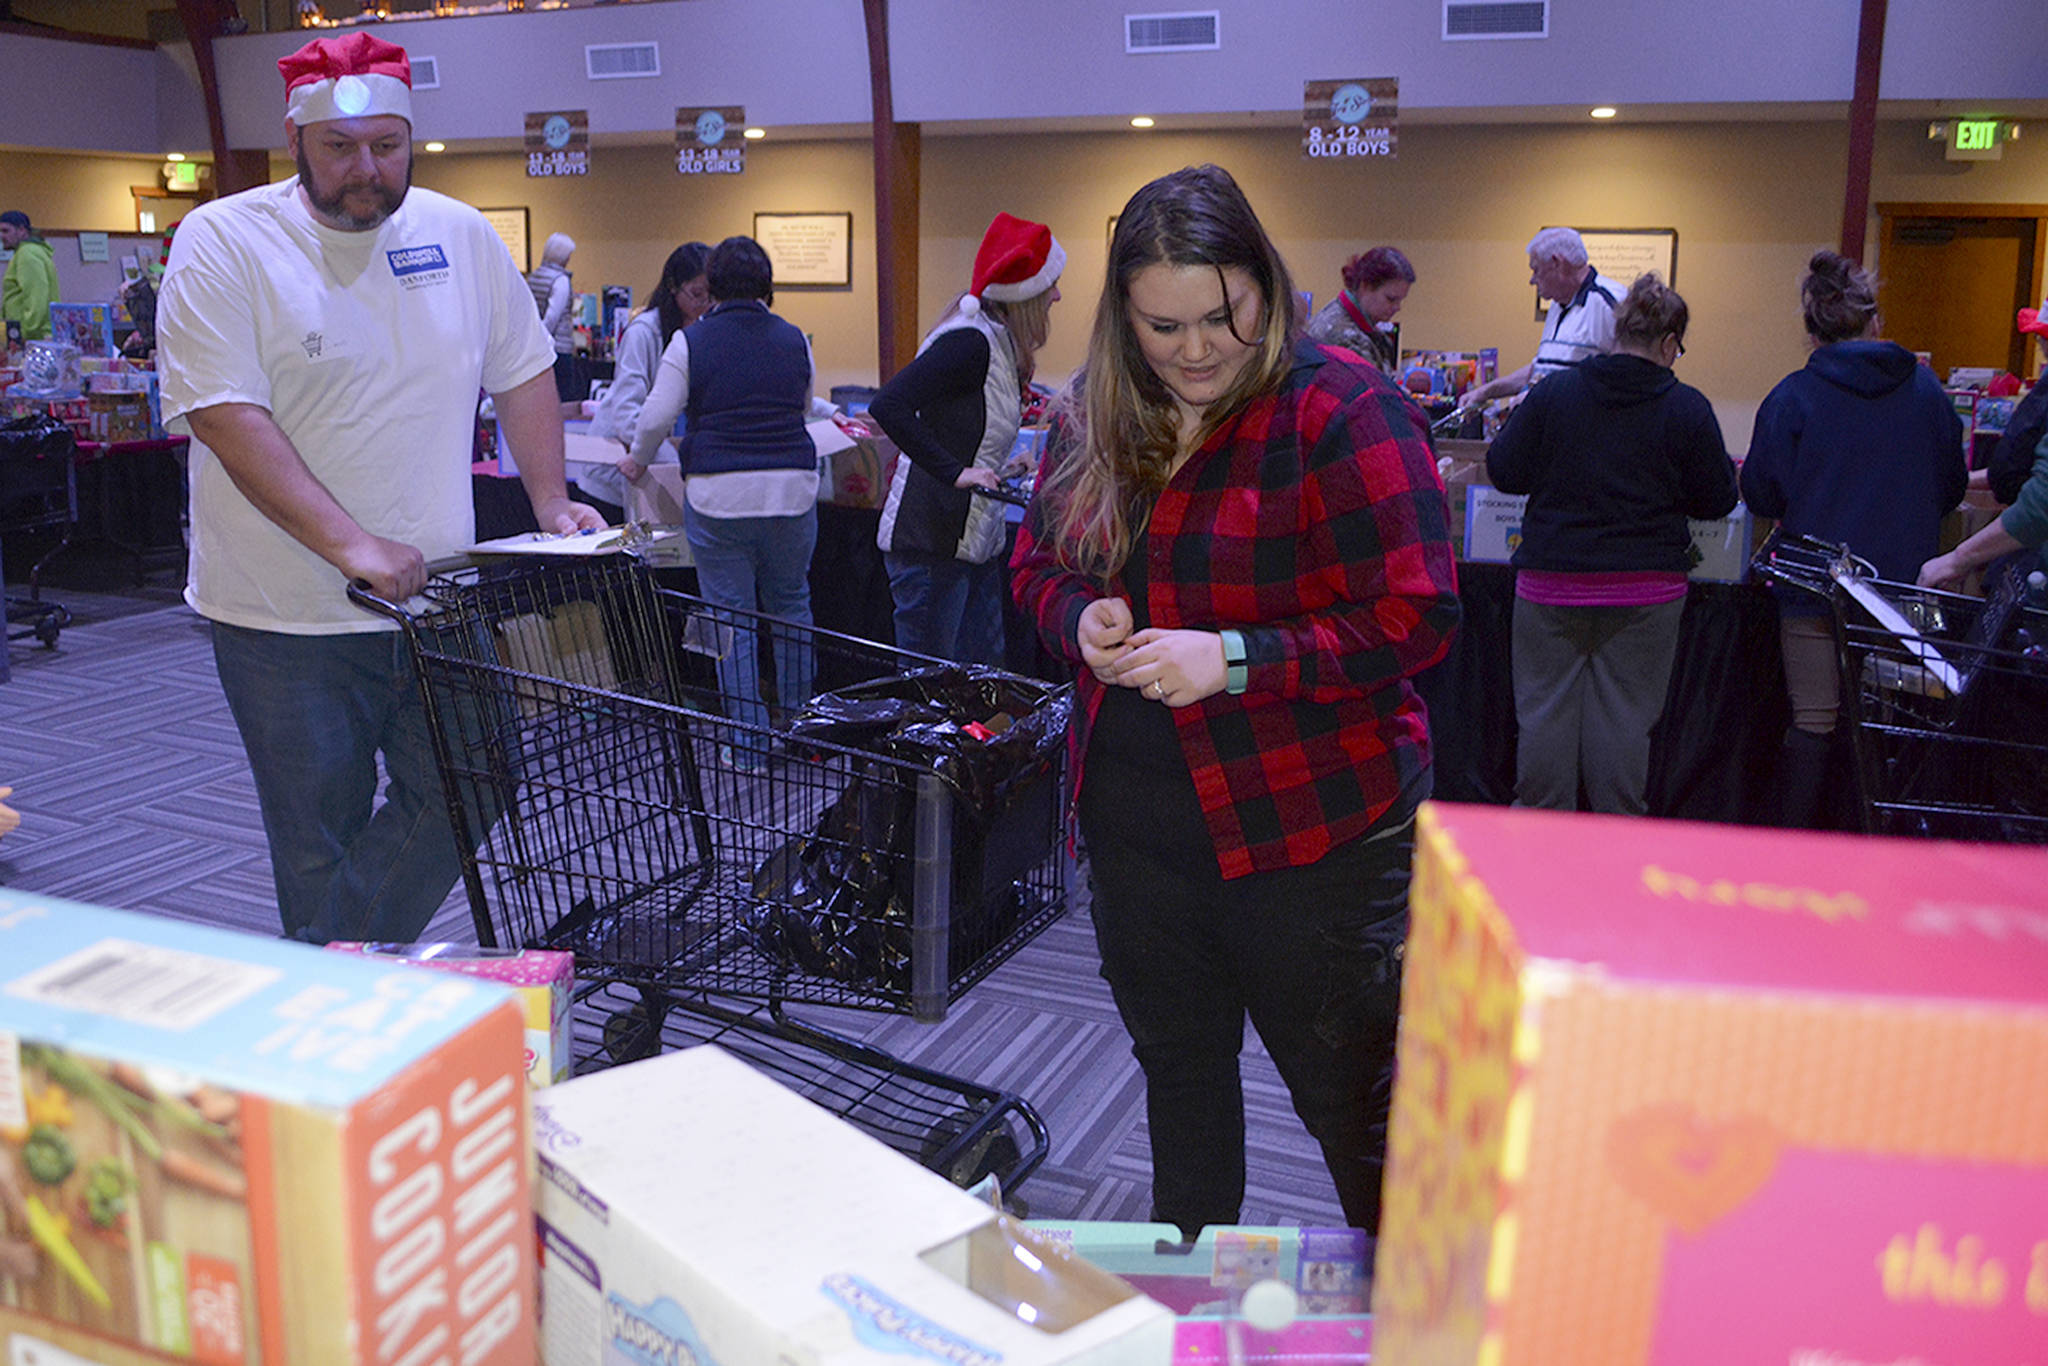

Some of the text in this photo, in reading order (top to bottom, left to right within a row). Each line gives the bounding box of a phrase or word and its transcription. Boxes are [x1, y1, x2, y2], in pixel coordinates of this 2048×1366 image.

[1364, 128, 1390, 138] YEAR
[1955, 121, 1998, 149] EXIT
[1308, 140, 1391, 157] OLD BOYS
[528, 162, 587, 176] OLD BOYS
[678, 160, 742, 174] OLD GIRLS
[449, 1072, 523, 1366] JUNIOR
